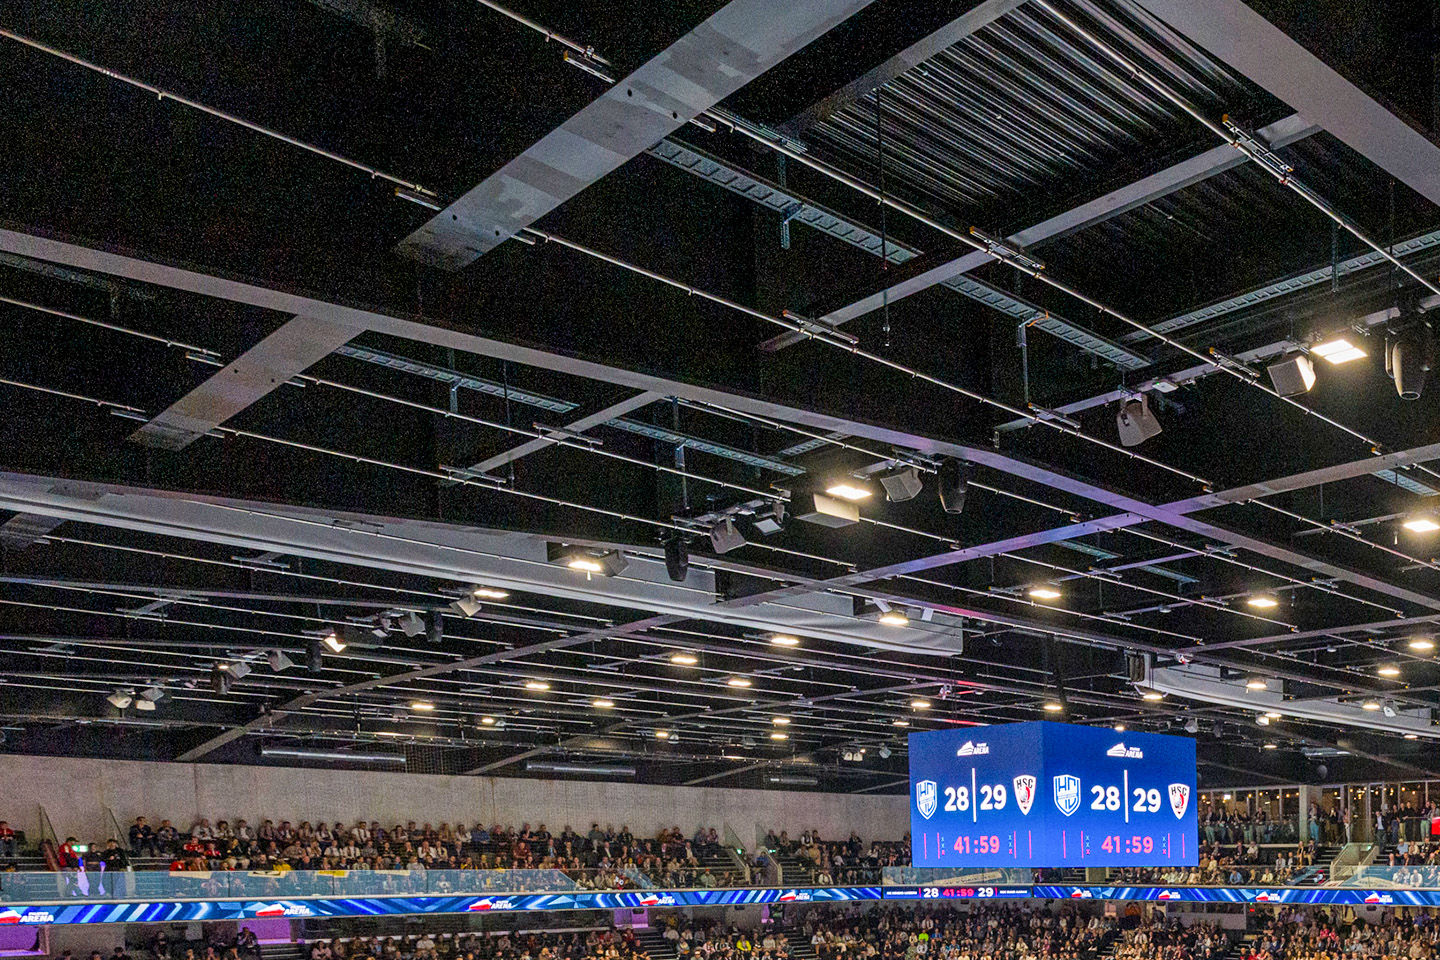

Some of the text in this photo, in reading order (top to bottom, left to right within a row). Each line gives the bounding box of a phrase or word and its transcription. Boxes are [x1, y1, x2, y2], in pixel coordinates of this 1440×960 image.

[1016, 777, 1034, 789] HSC
[944, 784, 1007, 812] 28 29
[1171, 786, 1187, 796] HSC
[1090, 785, 1161, 813] 28 29
[953, 836, 1000, 854] 41:59
[1101, 836, 1154, 854] 41:59
[923, 888, 940, 898] 28
[942, 888, 975, 897] 41:59
[977, 887, 994, 897] 29
[20, 915, 54, 923] ARENA
